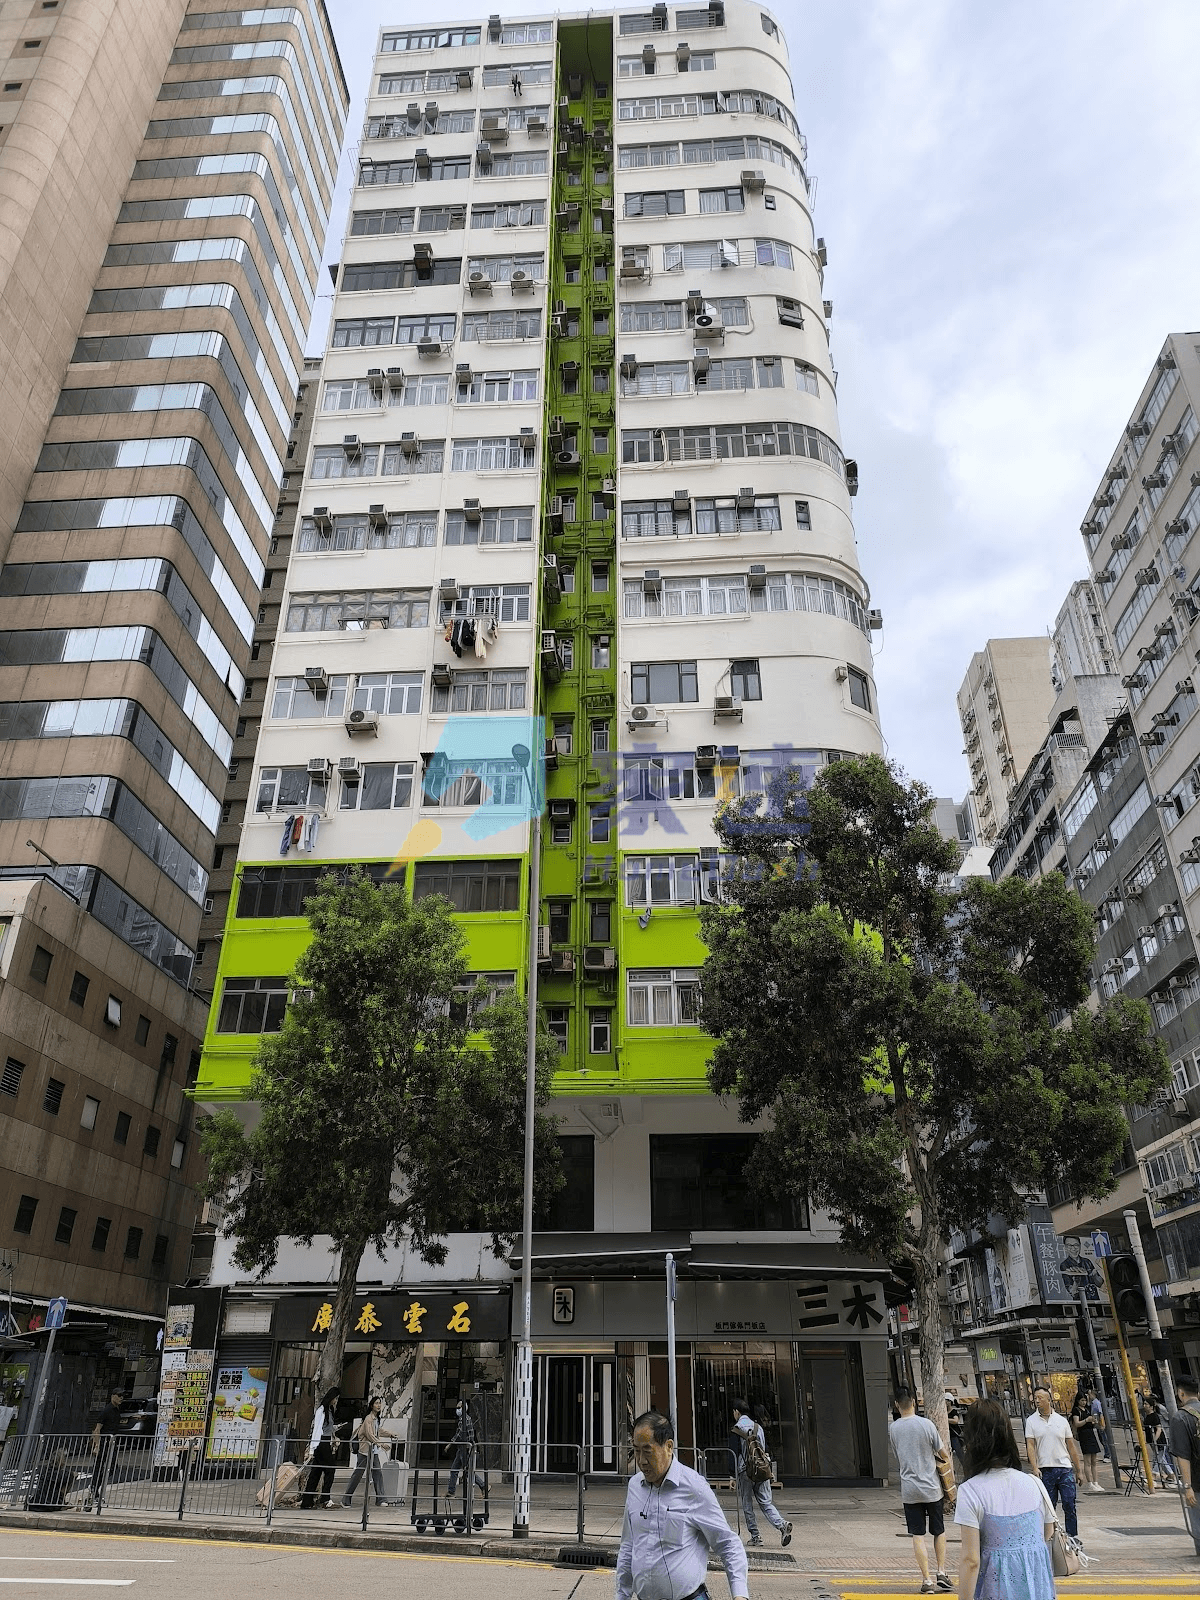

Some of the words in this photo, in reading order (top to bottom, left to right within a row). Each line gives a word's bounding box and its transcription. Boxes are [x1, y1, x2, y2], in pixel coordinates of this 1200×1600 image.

[1036, 1226, 1062, 1294] 午餐豚肉
[797, 1285, 884, 1329] 三木
